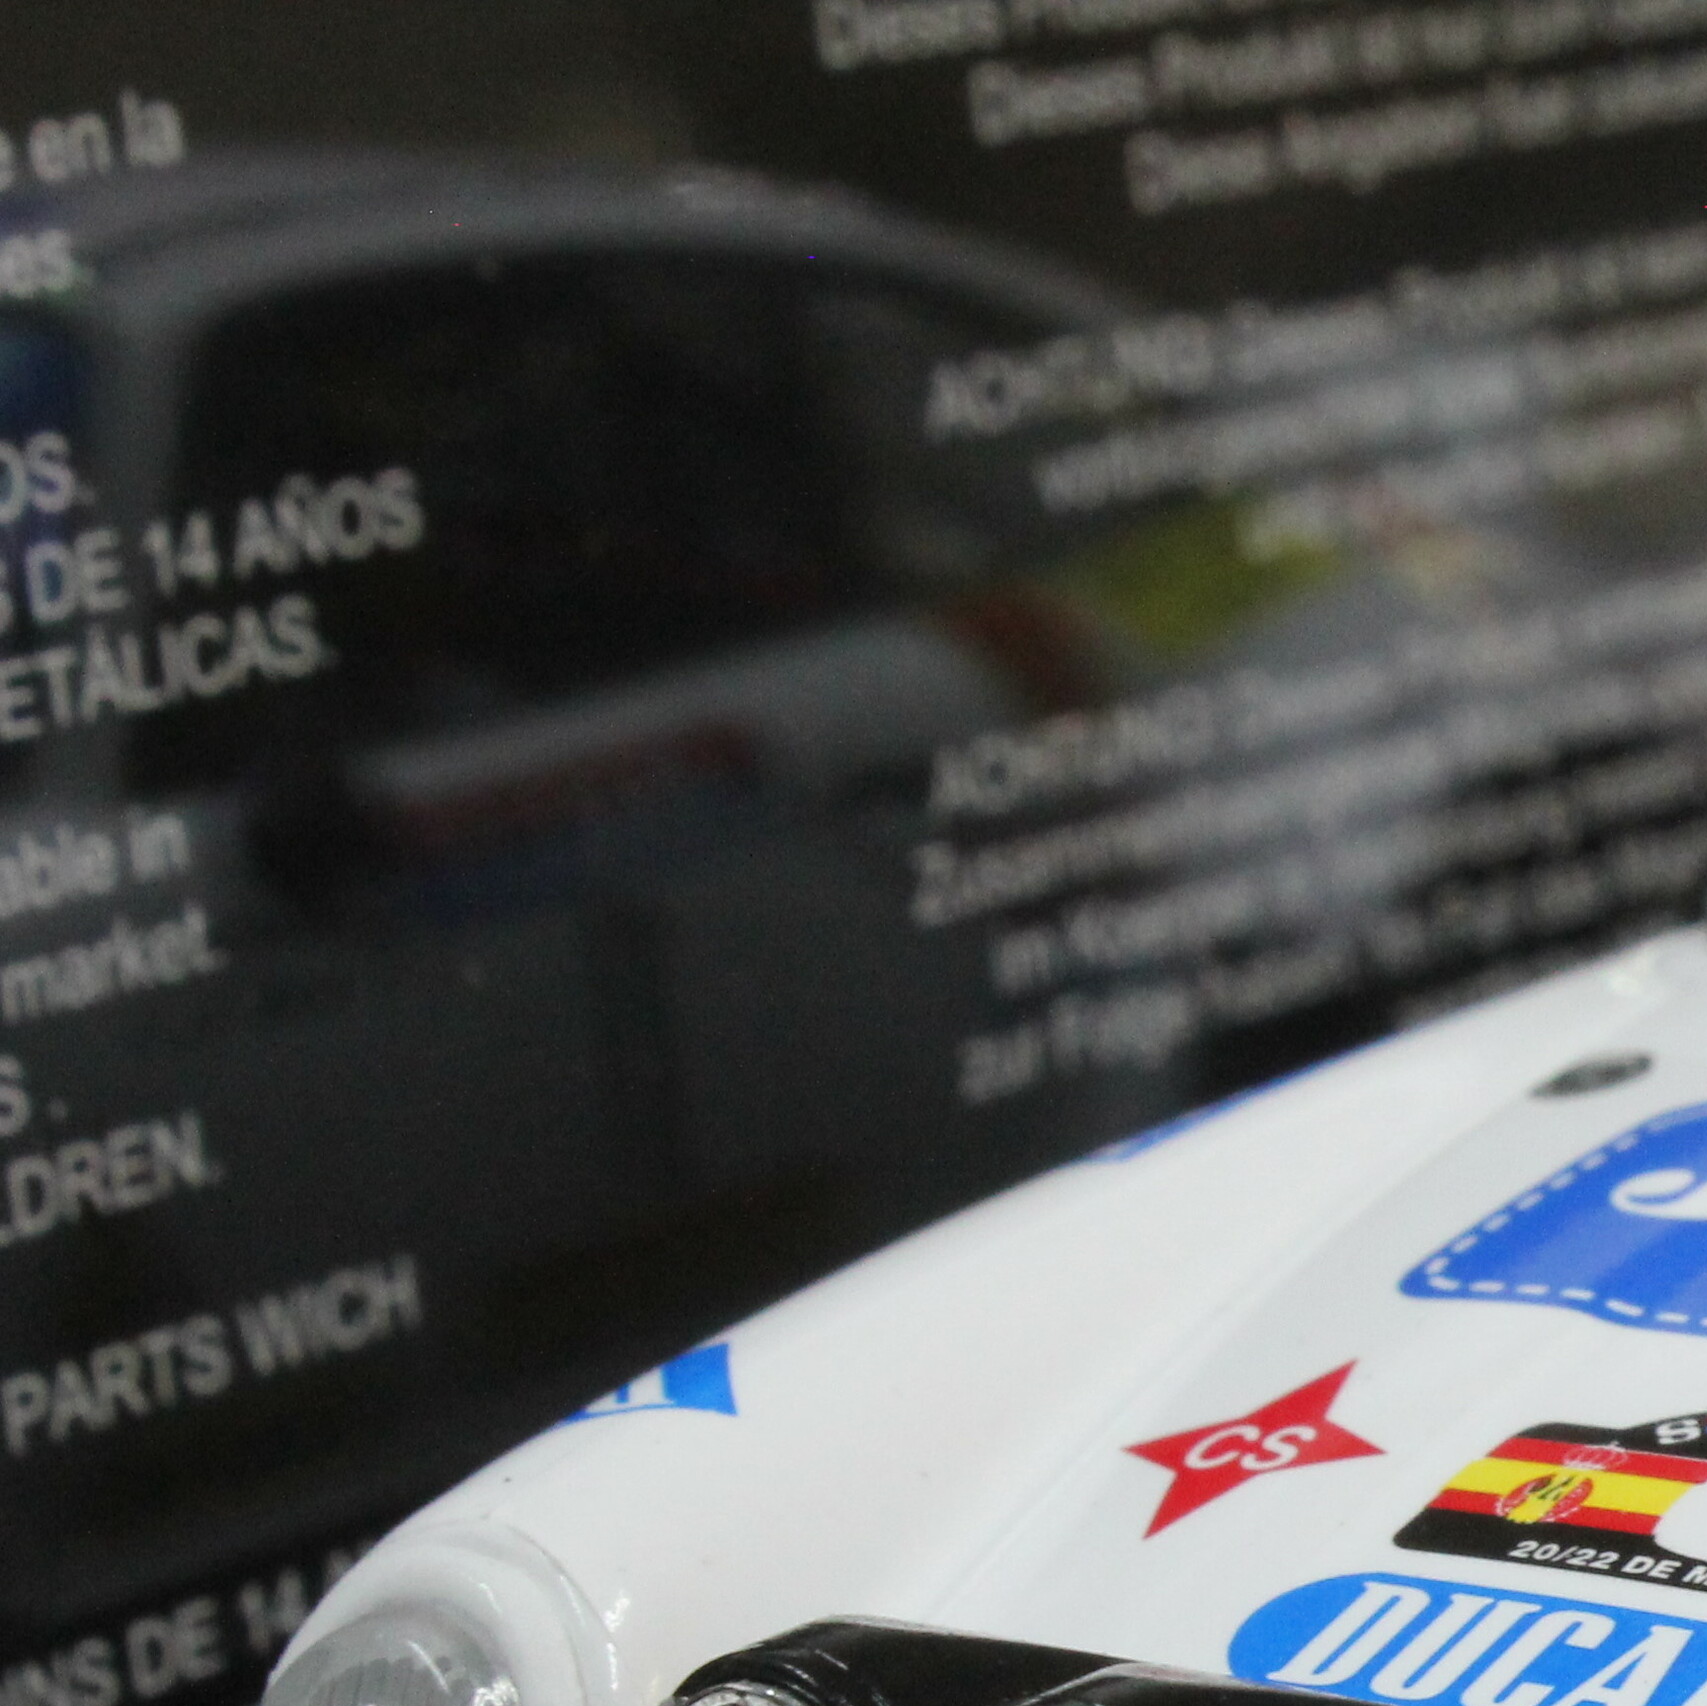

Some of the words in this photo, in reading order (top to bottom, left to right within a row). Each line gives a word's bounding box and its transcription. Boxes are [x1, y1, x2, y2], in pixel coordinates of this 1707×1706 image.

[27, 526, 130, 625] DE
[142, 507, 220, 597] 14
[233, 467, 426, 580] AÑOS
[3, 1313, 232, 1459] PARTS
[1184, 1424, 1318, 1471] CS
[1508, 1539, 1616, 1572] 20/22
[1621, 1553, 1676, 1580] DE
[124, 1596, 227, 1699] DE
